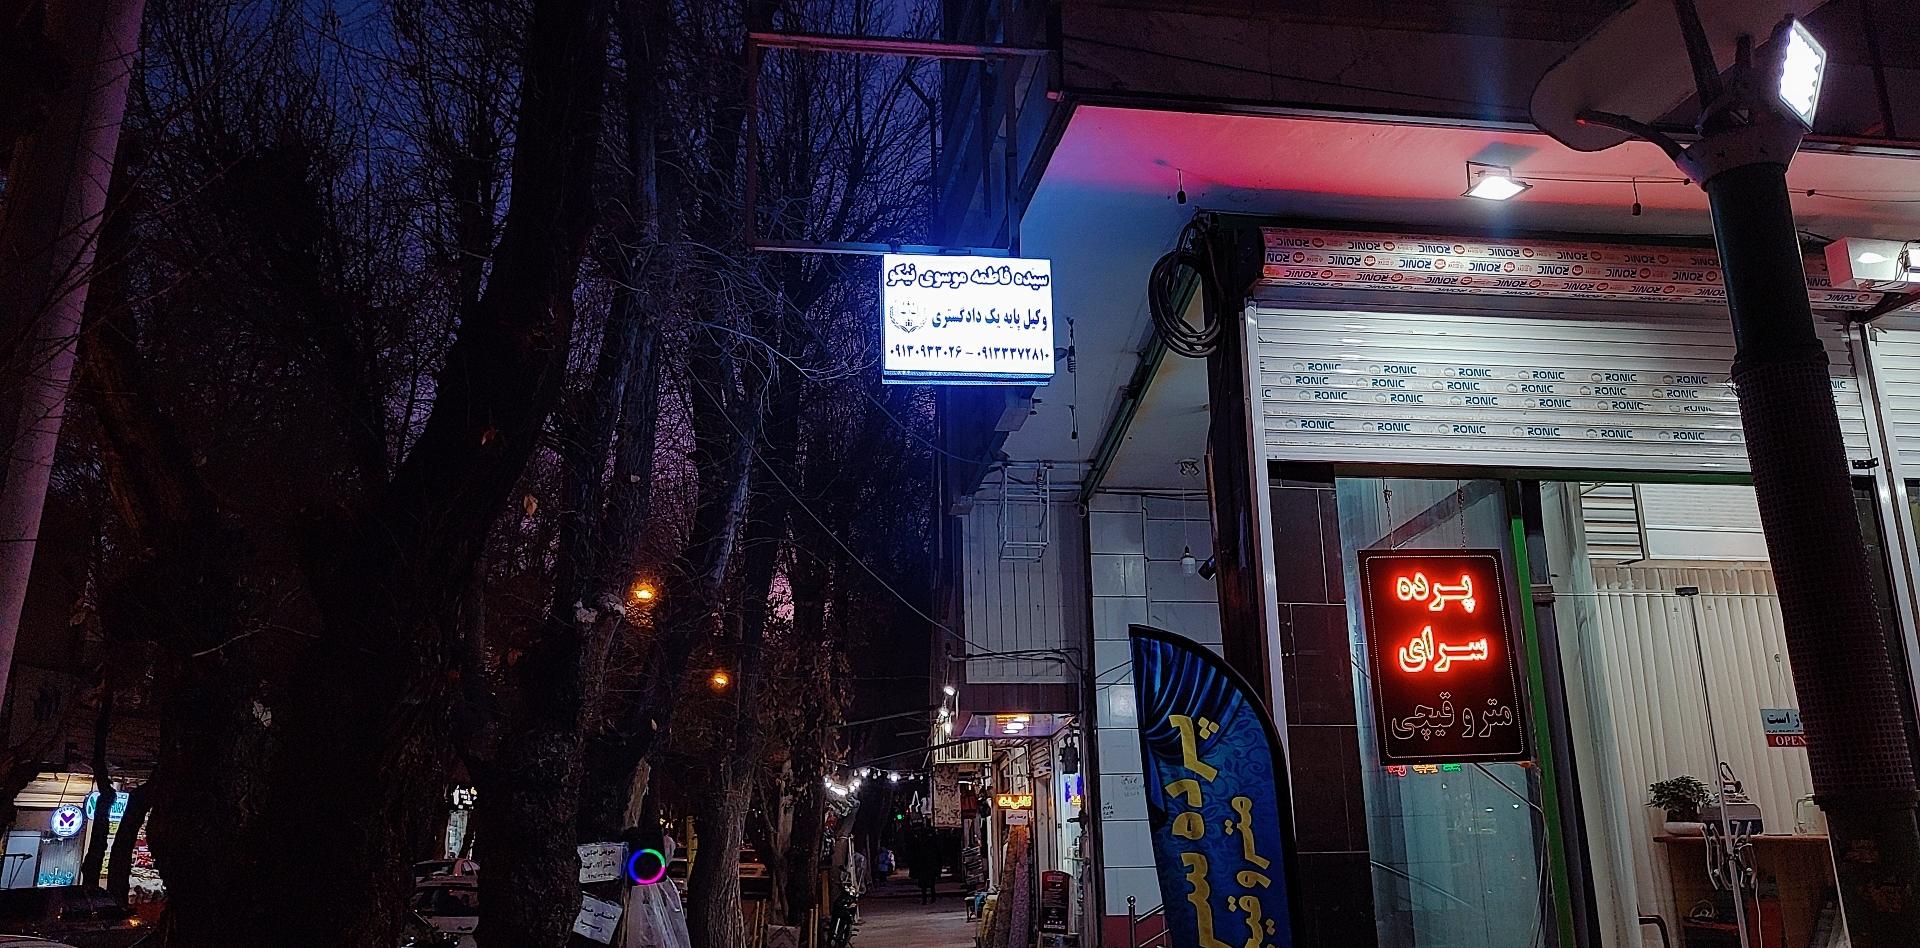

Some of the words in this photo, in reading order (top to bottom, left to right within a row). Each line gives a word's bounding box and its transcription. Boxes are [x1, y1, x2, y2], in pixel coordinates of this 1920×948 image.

[1276, 238, 1309, 247] RONIC
[1348, 241, 1380, 250] RONIC
[1418, 245, 1451, 253] RONIC
[1488, 248, 1520, 257] RONIC
[1557, 252, 1588, 260] RONIC
[886, 263, 916, 286] نیکو
[971, 266, 1012, 285] فاطمه
[1267, 252, 1290, 262] RON
[1328, 256, 1361, 265] RONIC
[1399, 260, 1431, 269] RONIC
[1469, 263, 1501, 272] RONIC
[1537, 266, 1569, 275] RONIC
[1605, 269, 1636, 278] RONIC
[1672, 272, 1703, 281] RONIC
[1284, 270, 1318, 278] RONIC
[985, 309, 1000, 328] یک
[1004, 310, 1020, 330] پایه
[1024, 309, 1047, 331] وکیل
[1295, 376, 1329, 384] RONIC
[1372, 379, 1405, 387] RONIC
[1447, 382, 1480, 390] RONIC
[1521, 384, 1554, 393] RONIC
[1595, 387, 1626, 395] RONIC
[1666, 390, 1698, 398] RONIC
[1384, 365, 1417, 374] RONIC
[1459, 368, 1491, 377] RONIC
[1533, 371, 1565, 380] RONIC
[1605, 373, 1637, 382] RONIC
[1676, 376, 1708, 384] RONIC
[1830, 381, 1846, 389] NIC
[1314, 391, 1347, 399] RONIC
[1390, 394, 1423, 403] RONIC
[1465, 396, 1498, 405] RONIC
[1539, 399, 1571, 407] RONIC
[1612, 401, 1644, 410] RONIC
[1301, 420, 1334, 429] RONIC
[1378, 423, 1411, 431] RONIC
[1453, 425, 1486, 434] RONIC
[1528, 427, 1560, 436] RONIC
[1601, 430, 1633, 438] RONIC
[1673, 432, 1705, 440] RONIC
[1396, 572, 1476, 613] پرده
[1399, 625, 1488, 673] سرای
[1391, 691, 1455, 740] قیچی
[1462, 707, 1474, 738] و
[1479, 698, 1513, 738] متر
[1767, 711, 1790, 724] است
[1775, 736, 1806, 746] OPEN
[1225, 796, 1271, 870] متر
